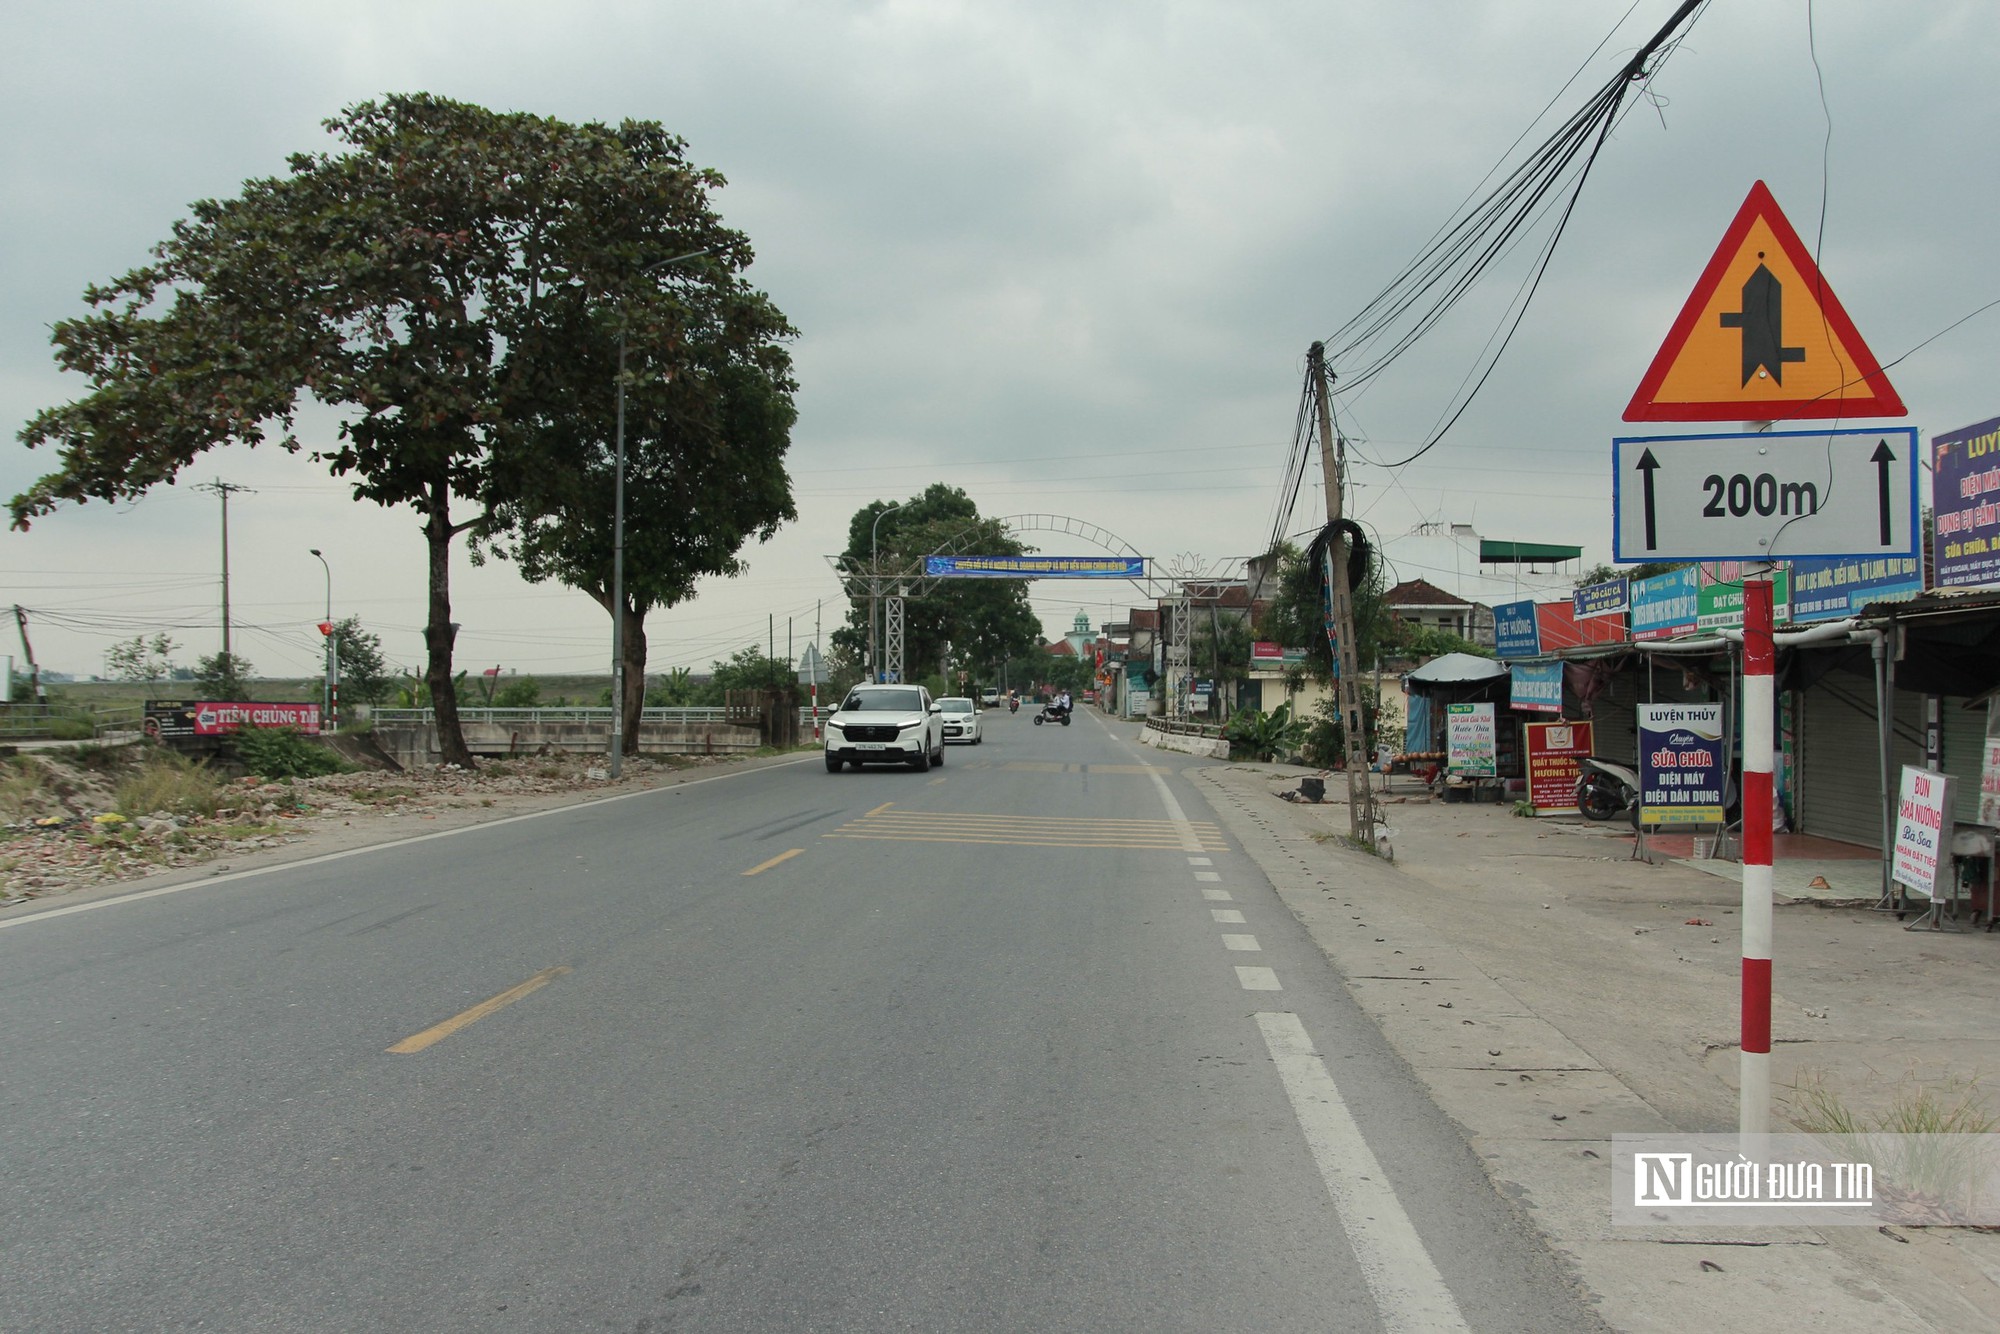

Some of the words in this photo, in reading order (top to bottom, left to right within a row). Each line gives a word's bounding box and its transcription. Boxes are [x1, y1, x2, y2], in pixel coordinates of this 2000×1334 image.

[1968, 426, 2000, 459] LUY
[1703, 473, 1817, 517] 200m
[1960, 471, 1982, 500] ĐIỆN
[1937, 511, 1960, 538] DỤNG
[1961, 508, 1974, 533] CỤ
[1796, 572, 1806, 592] MÁY
[1728, 592, 1744, 606] CHU
[218, 705, 250, 723] TIÊM
[253, 704, 297, 723] CHỦNG
[1650, 708, 1683, 724] LUYỆN
[1687, 707, 1716, 720] THỦY
[1669, 734, 1694, 746] Chuyên
[1651, 747, 1677, 768] SỬA
[1679, 748, 1713, 768] CHỮA
[1534, 768, 1565, 777] HƯƠNG
[1659, 771, 1681, 788] ĐIỆN
[1684, 771, 1705, 785] MÁY
[1914, 773, 1931, 798] BÚN
[1645, 788, 1667, 805] ĐIỆN
[1670, 788, 1689, 803] DÂN
[1692, 790, 1719, 804] DỤNG
[1915, 803, 1941, 830] NƯỚNG
